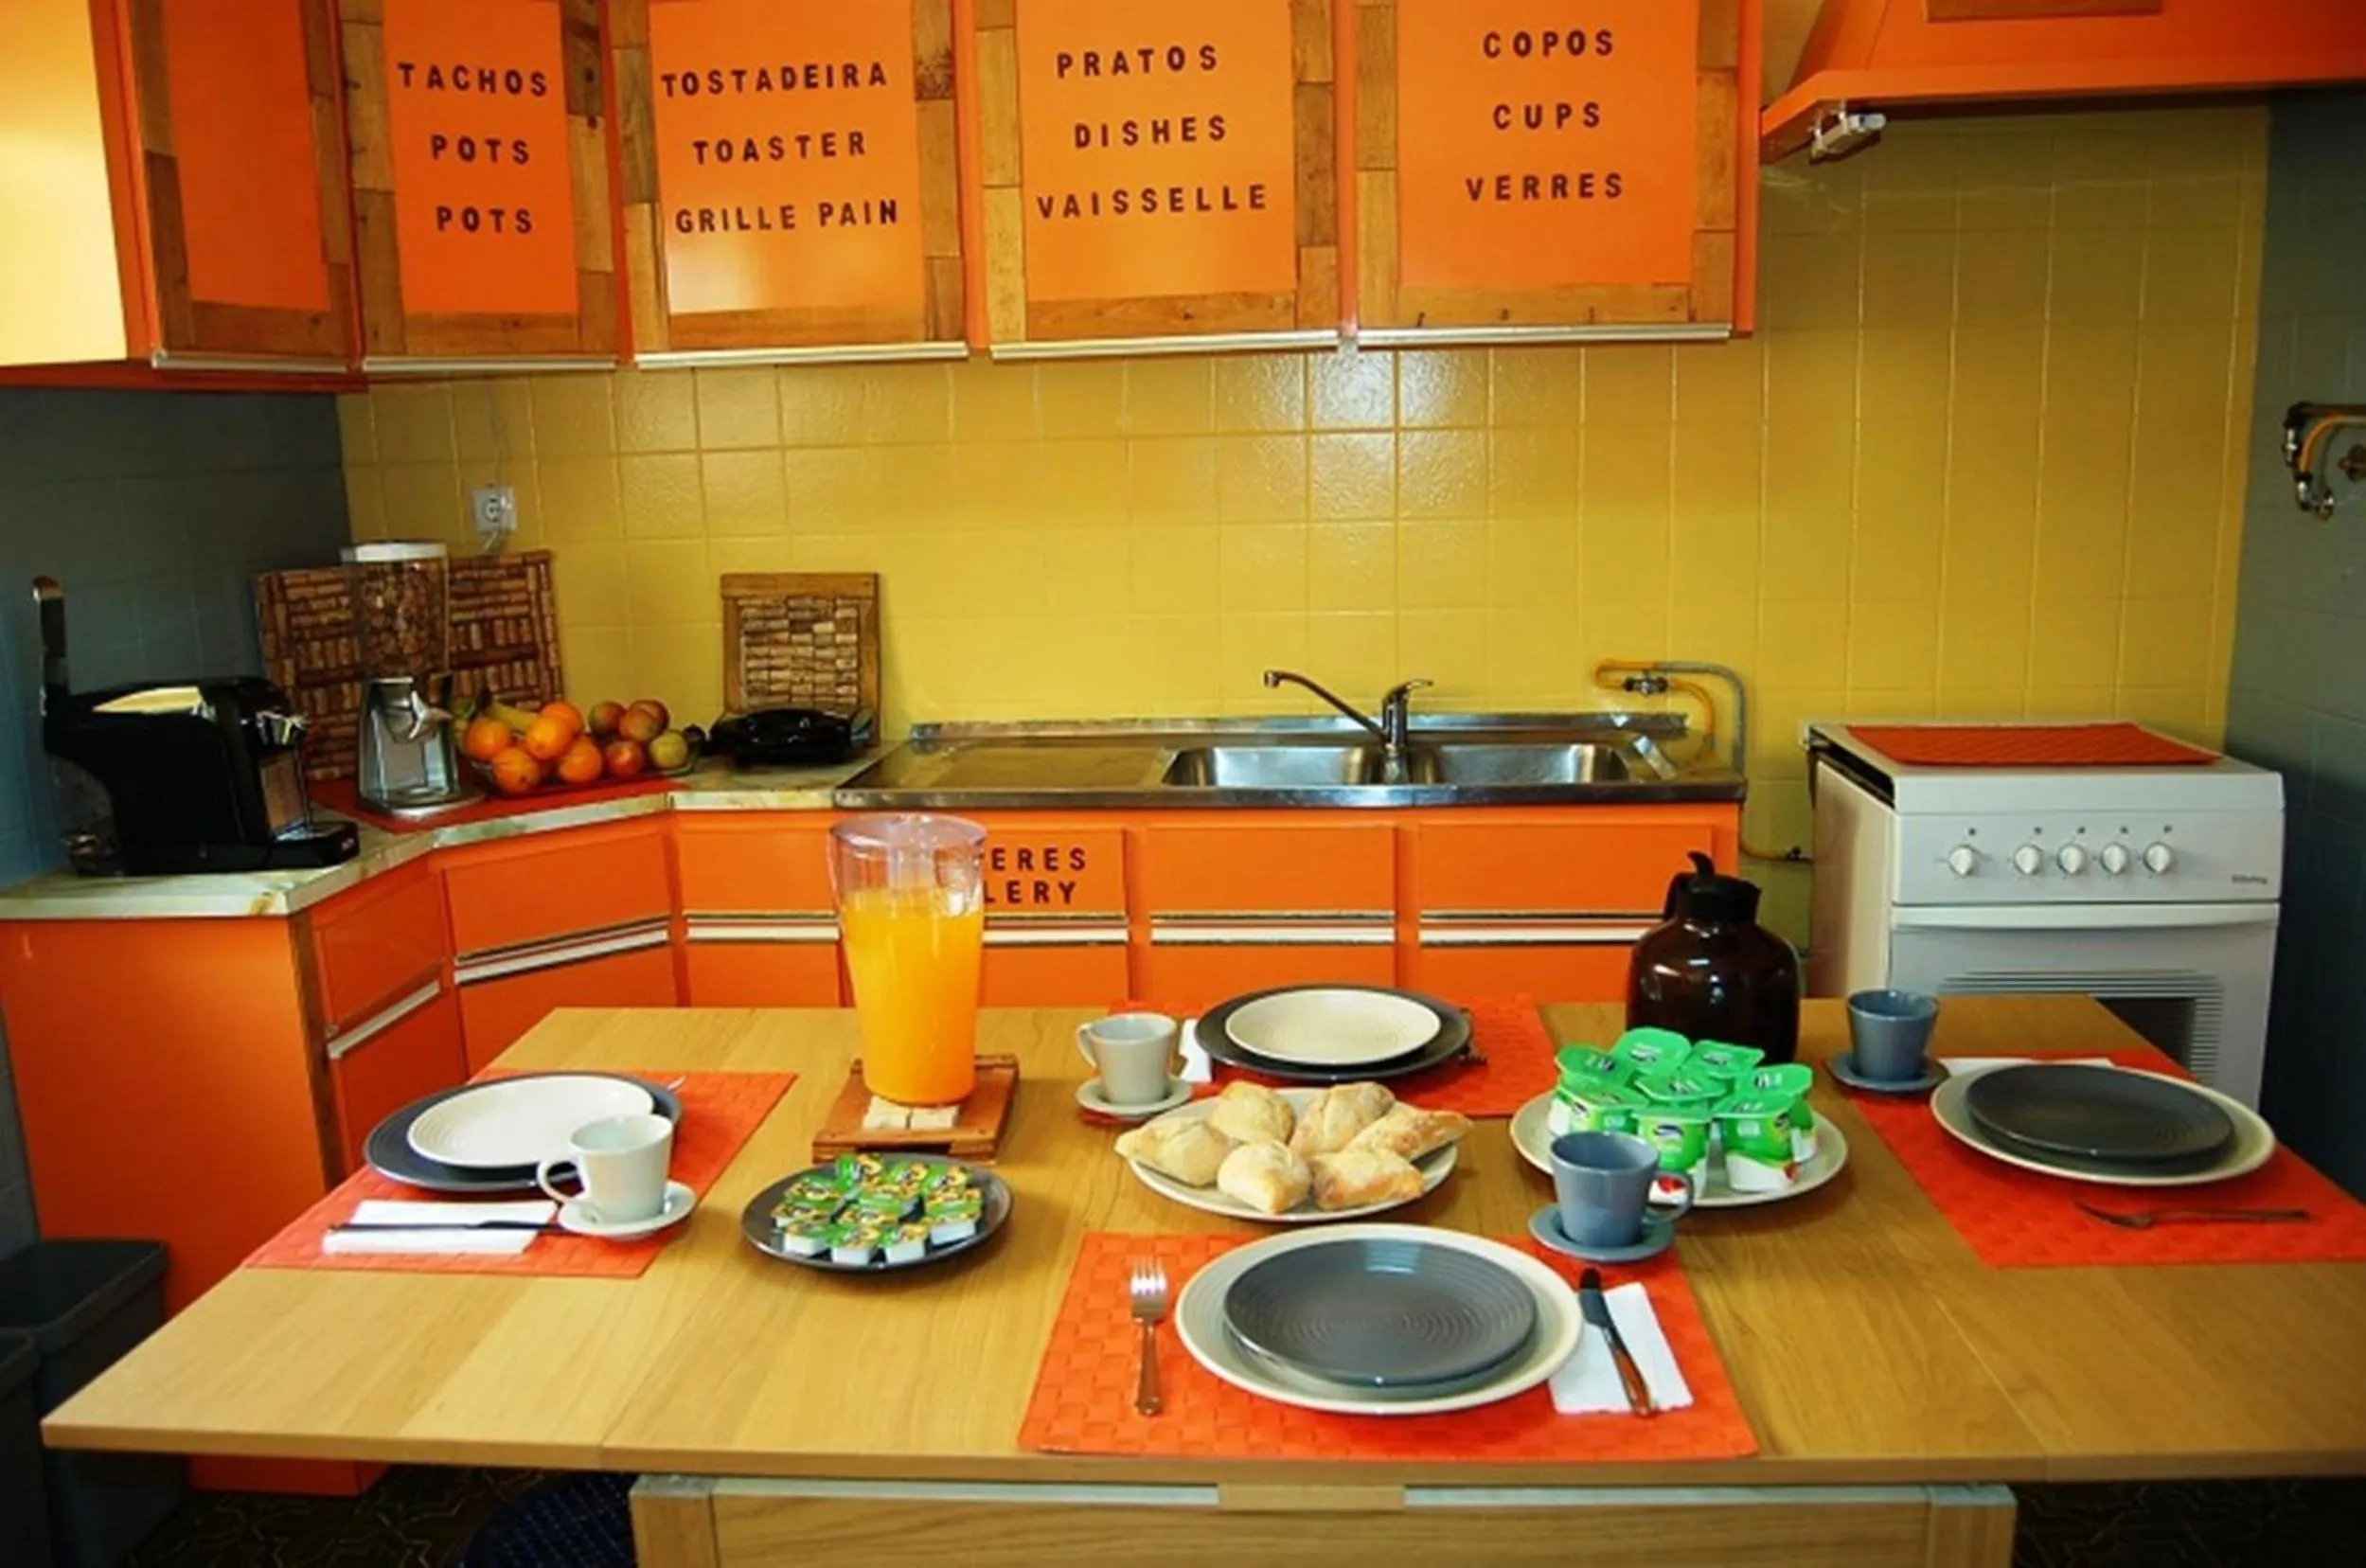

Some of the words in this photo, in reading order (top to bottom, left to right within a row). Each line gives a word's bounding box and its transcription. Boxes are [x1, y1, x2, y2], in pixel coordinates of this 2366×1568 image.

[1484, 29, 1612, 58] COPOS
[1057, 45, 1217, 78] PRATOS
[398, 62, 546, 97] TACHOS
[662, 62, 886, 97] TOSTADEIRA
[1493, 102, 1600, 130] CUPS
[1075, 116, 1225, 148] DISHES
[431, 134, 529, 165] POTS
[693, 133, 864, 164] TOASTER
[1038, 185, 1265, 218] VAISSELLE
[1466, 172, 1622, 202] VERRES
[436, 205, 532, 234] POTS
[676, 205, 795, 233] GRILLE
[819, 200, 897, 227] PAIN
[991, 847, 1086, 871] ERES
[984, 881, 1076, 904] LERY
